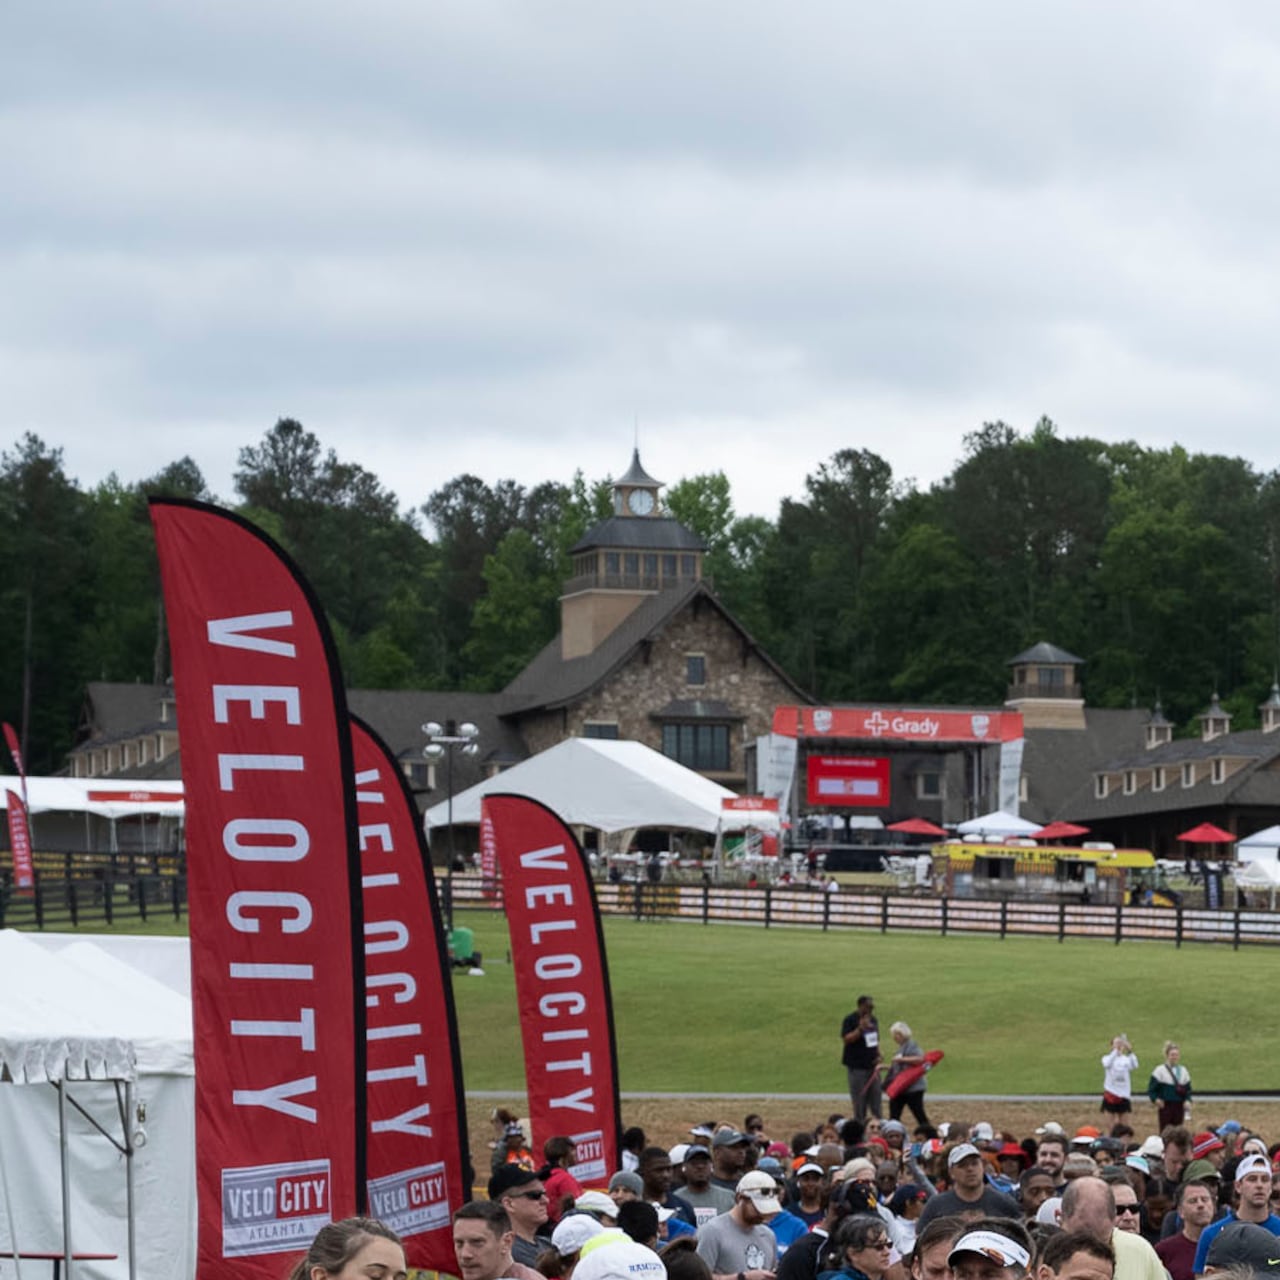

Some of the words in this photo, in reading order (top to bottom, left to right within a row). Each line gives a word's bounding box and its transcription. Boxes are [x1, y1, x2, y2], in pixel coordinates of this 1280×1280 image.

[891, 716, 940, 737] Grady
[206, 610, 318, 1123] VELOCITY
[520, 844, 595, 1115] VELOCITY
[228, 1186, 275, 1219] VELO
[280, 1178, 326, 1214] CITY
[373, 1190, 408, 1217] VELO
[409, 1177, 444, 1207] CITY
[248, 1223, 305, 1242] ATLANTA
